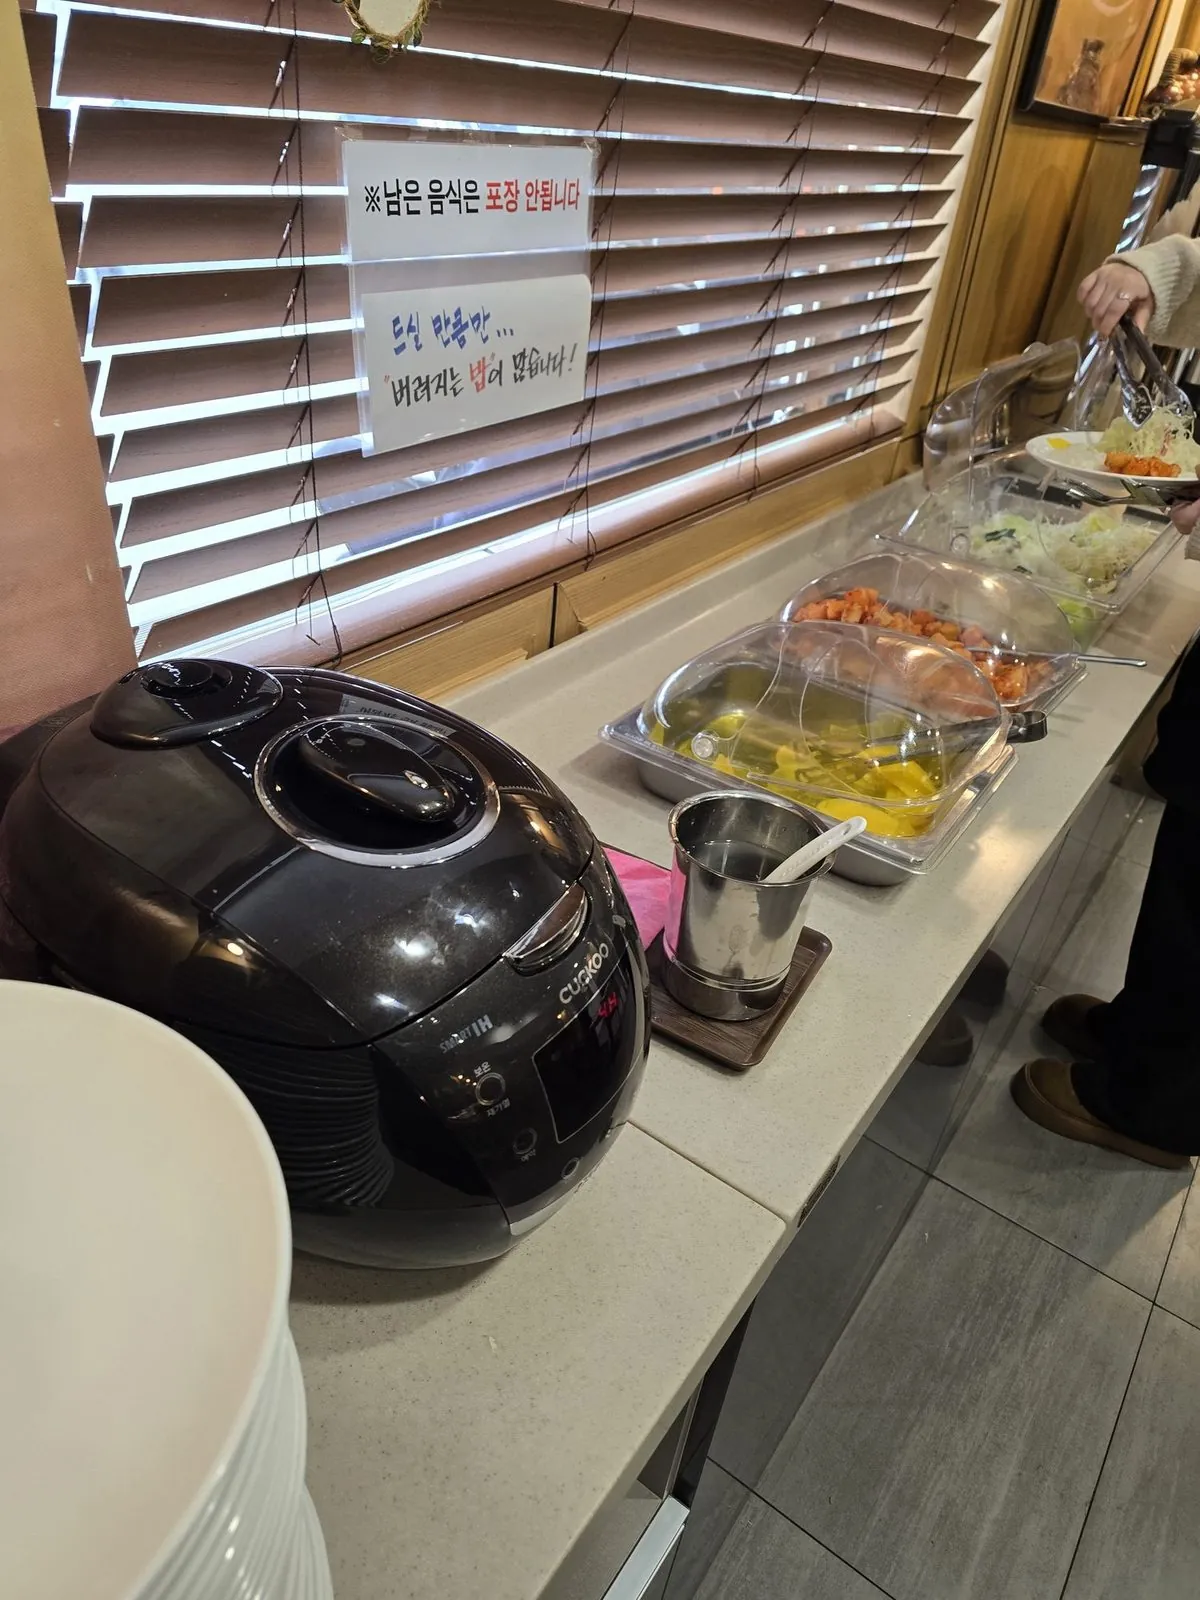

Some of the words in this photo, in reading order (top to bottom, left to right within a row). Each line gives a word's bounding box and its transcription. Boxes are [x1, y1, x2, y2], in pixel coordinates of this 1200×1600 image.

[364, 178, 422, 217] ※남은
[427, 179, 480, 216] 음식은
[485, 179, 520, 213] 포장
[525, 178, 580, 212] 안됩니다
[392, 311, 423, 356] 드실
[559, 942, 609, 1004] CUCKOO
